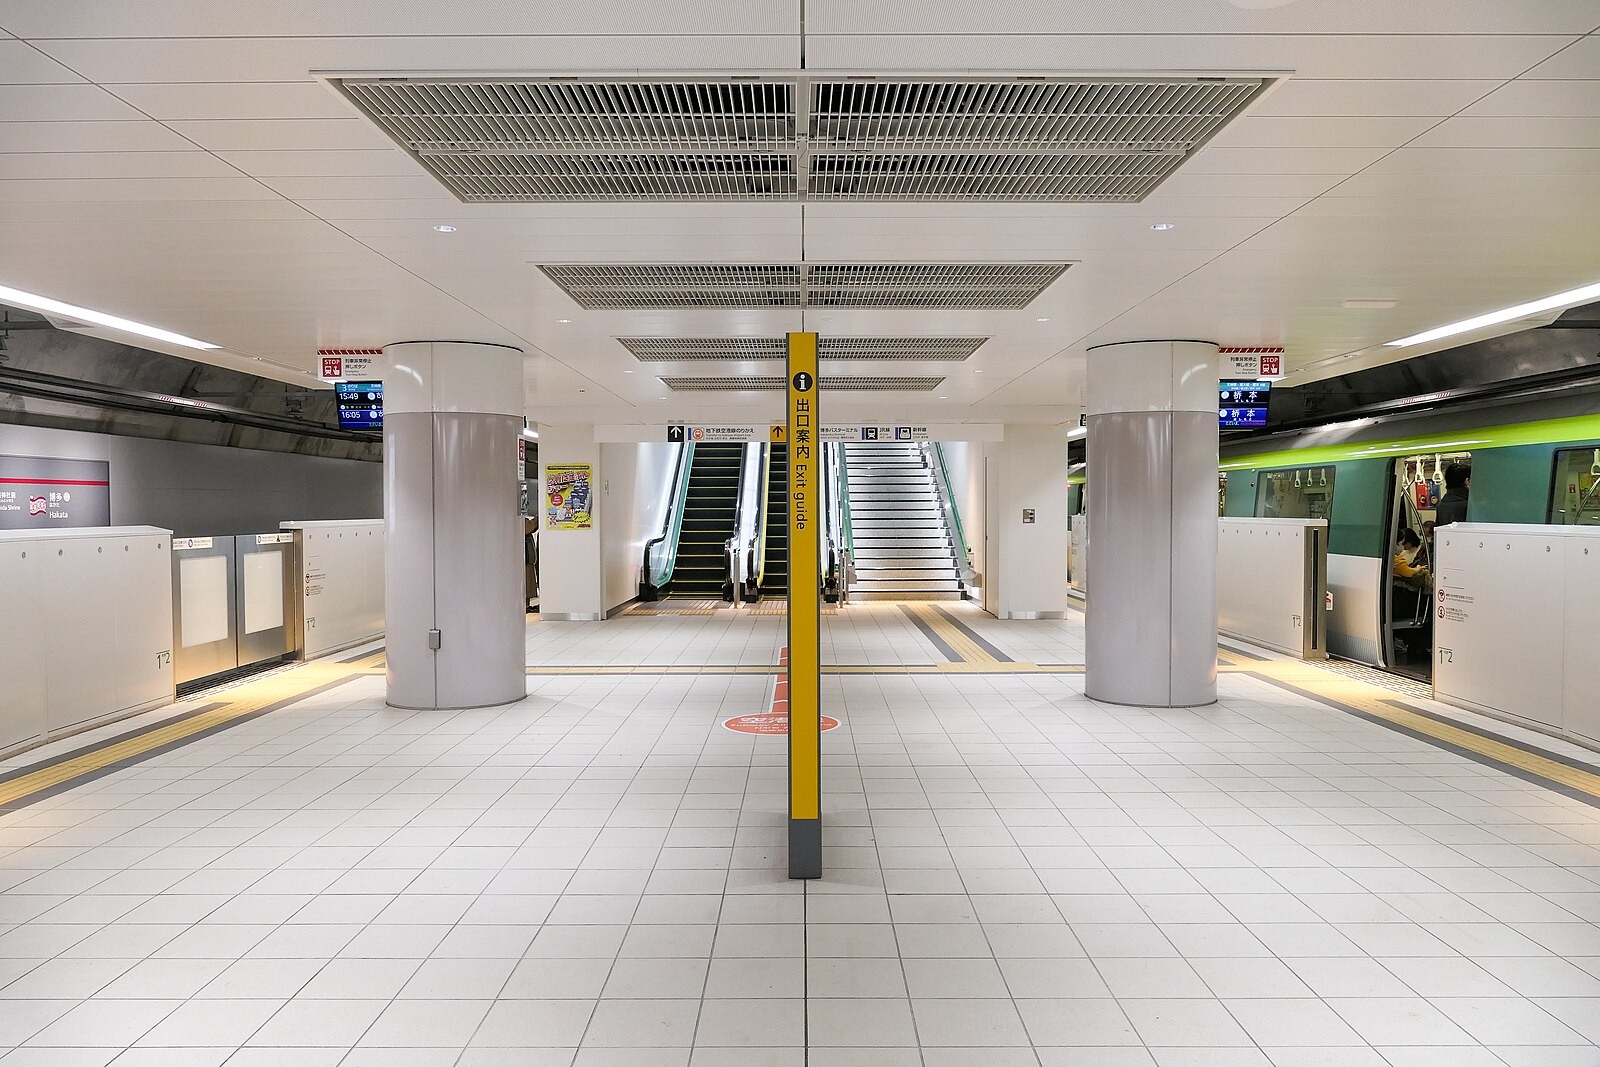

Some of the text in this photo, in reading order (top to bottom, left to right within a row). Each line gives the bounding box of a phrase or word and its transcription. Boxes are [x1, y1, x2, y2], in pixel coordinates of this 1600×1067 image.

[342, 384, 347, 392] 3
[341, 411, 361, 419] 16:05
[796, 397, 810, 459] 出口案内
[49, 492, 63, 502] 博多
[793, 464, 808, 530] Exit guide
[49, 511, 69, 519] Hakata
